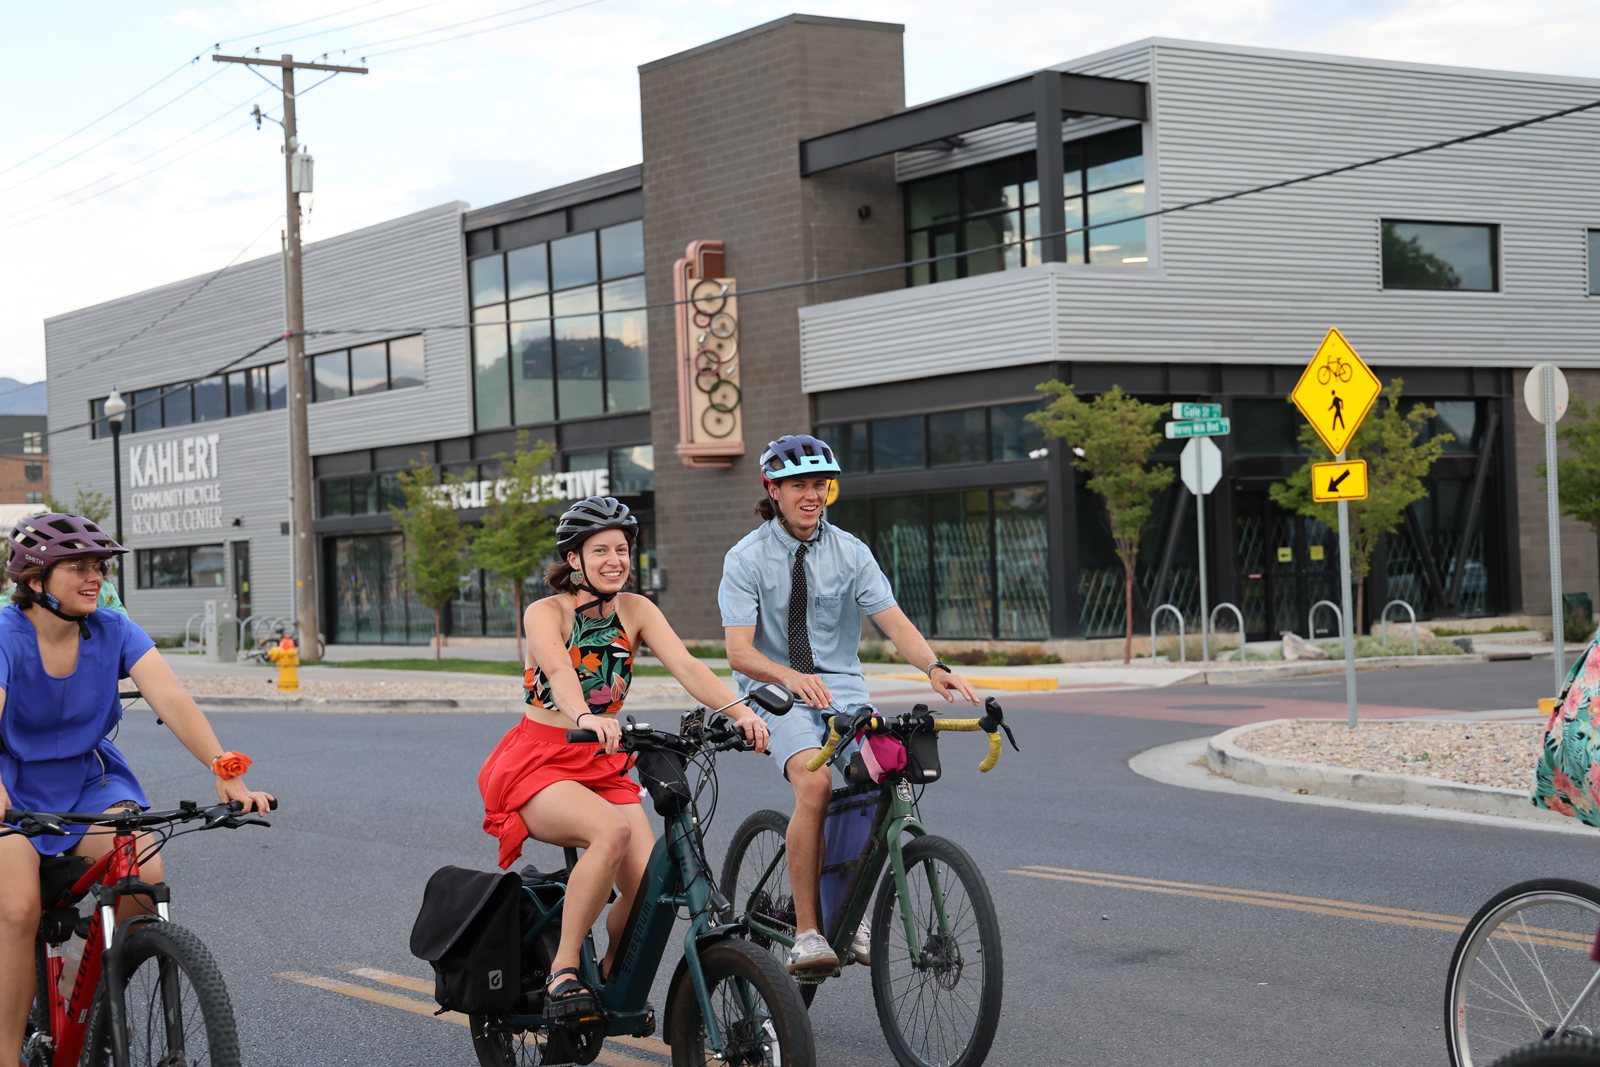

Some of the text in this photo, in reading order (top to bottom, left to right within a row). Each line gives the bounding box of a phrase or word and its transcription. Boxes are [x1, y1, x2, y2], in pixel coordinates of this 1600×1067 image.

[129, 433, 220, 488] KAHLERT
[131, 483, 222, 511] COMMUNITY BICYCLE
[132, 506, 222, 535] RESOURCE CENTER
[25, 553, 44, 566] SMITH
[624, 900, 652, 969] magnum
